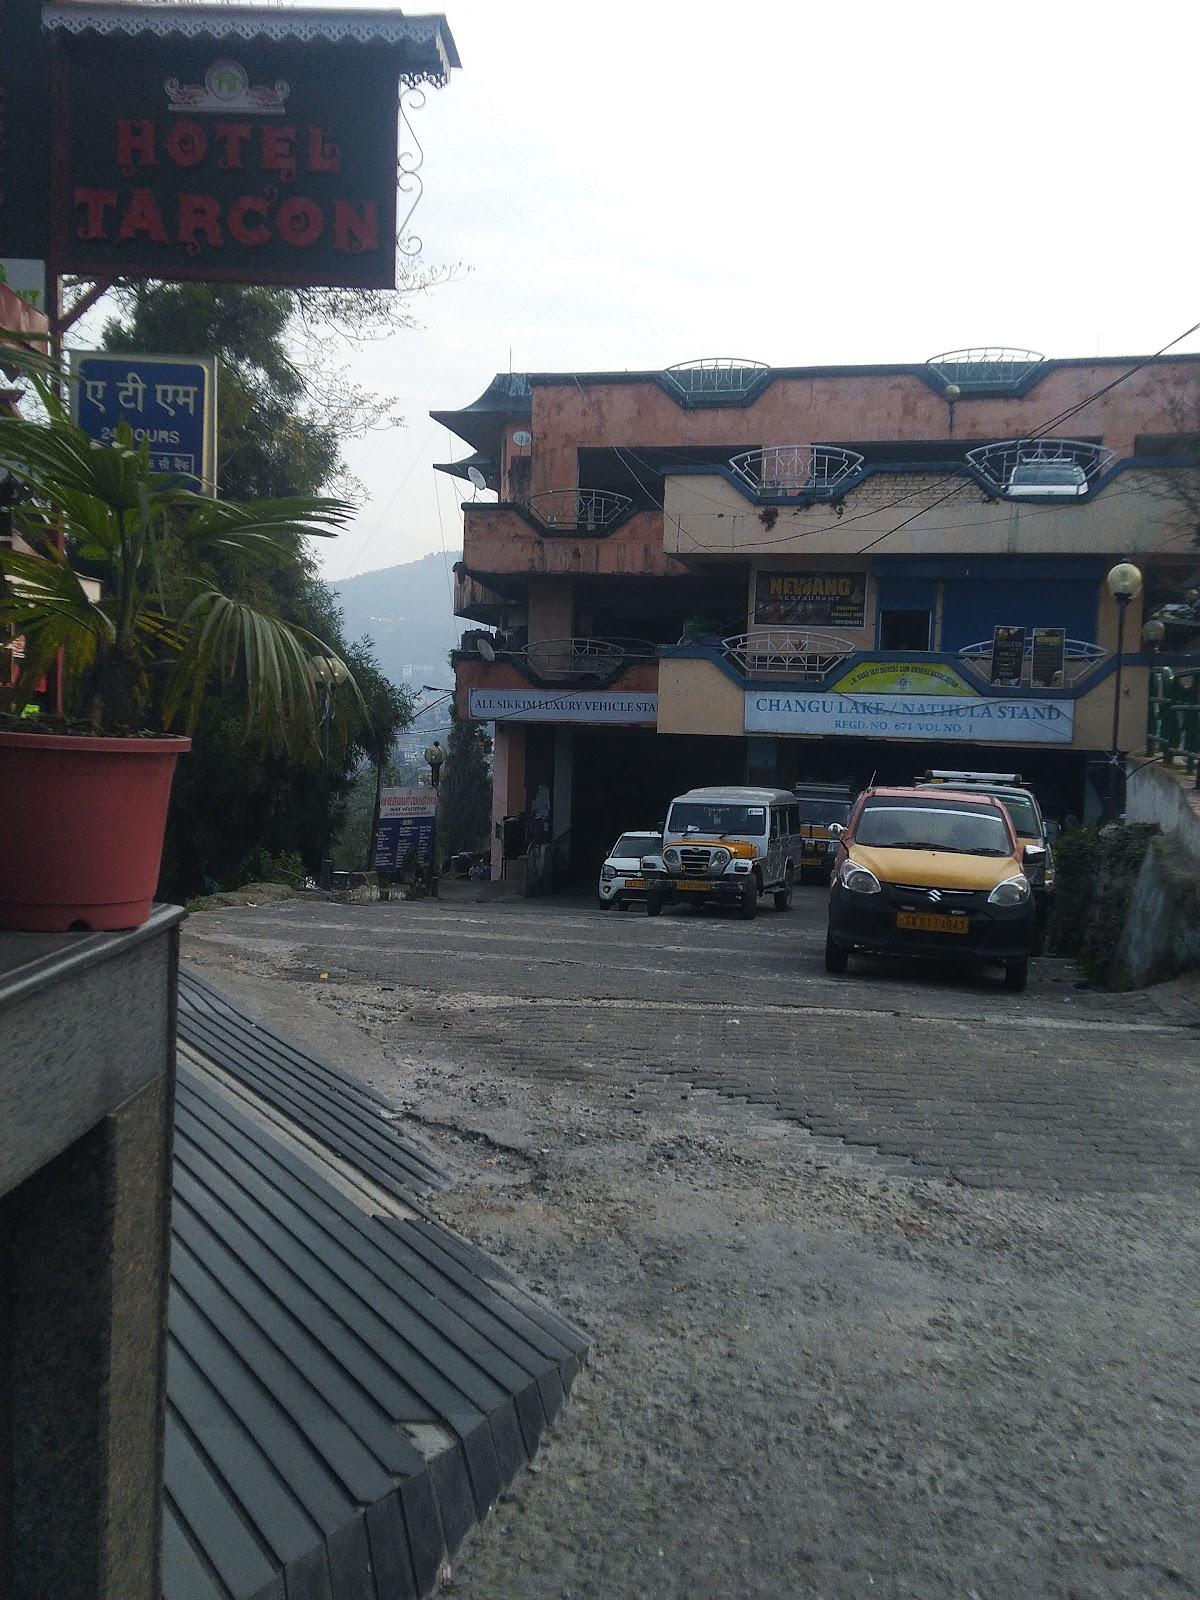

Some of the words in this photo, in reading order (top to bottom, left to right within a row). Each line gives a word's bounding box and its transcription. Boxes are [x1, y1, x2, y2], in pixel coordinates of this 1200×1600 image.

[115, 119, 342, 183] HOTEL
[74, 186, 379, 256] TARCON
[86, 380, 107, 411] ए
[116, 372, 147, 412] टी
[155, 384, 198, 416] एम
[131, 428, 180, 444] OURS
[475, 699, 495, 709] ALL
[497, 700, 536, 710] SIKKIM
[538, 700, 582, 711] LUXURY
[584, 701, 634, 712] VEHICLE
[756, 698, 833, 714] CHANGU
[837, 701, 885, 715] LAKE
[902, 703, 993, 718] NATHULA
[996, 704, 1061, 721] STAND
[894, 721, 913, 731] 671
